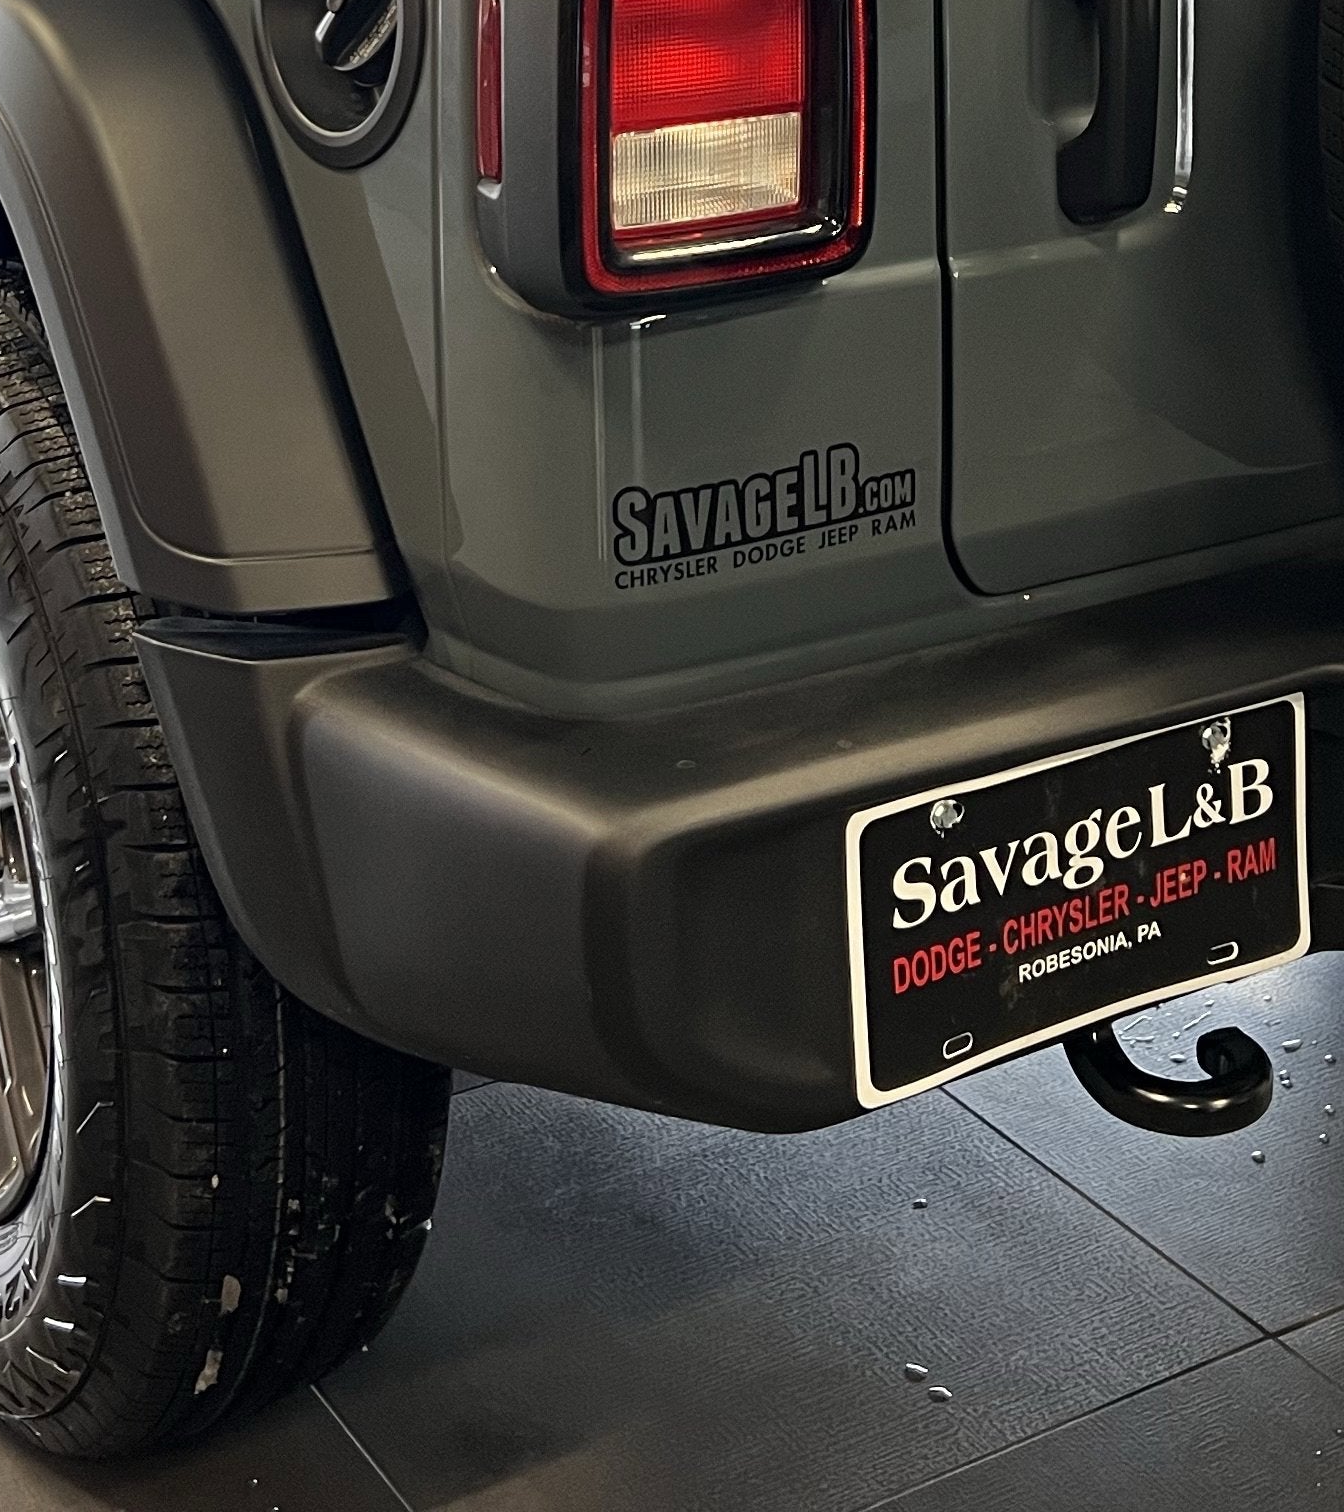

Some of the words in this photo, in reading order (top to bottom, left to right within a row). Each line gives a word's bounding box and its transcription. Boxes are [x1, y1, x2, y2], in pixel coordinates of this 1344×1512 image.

[614, 555, 719, 589] CHRYSLER
[732, 535, 807, 569] DODGE
[817, 524, 859, 550] JEEP
[871, 509, 917, 537] RAM
[893, 930, 983, 995] DODGE
[1002, 883, 1131, 956] CHRYSLER
[1150, 858, 1208, 908] JEEP
[1226, 836, 1278, 884] RAM
[1018, 931, 1133, 984] ROBESONIA,
[1137, 920, 1162, 945] PA
